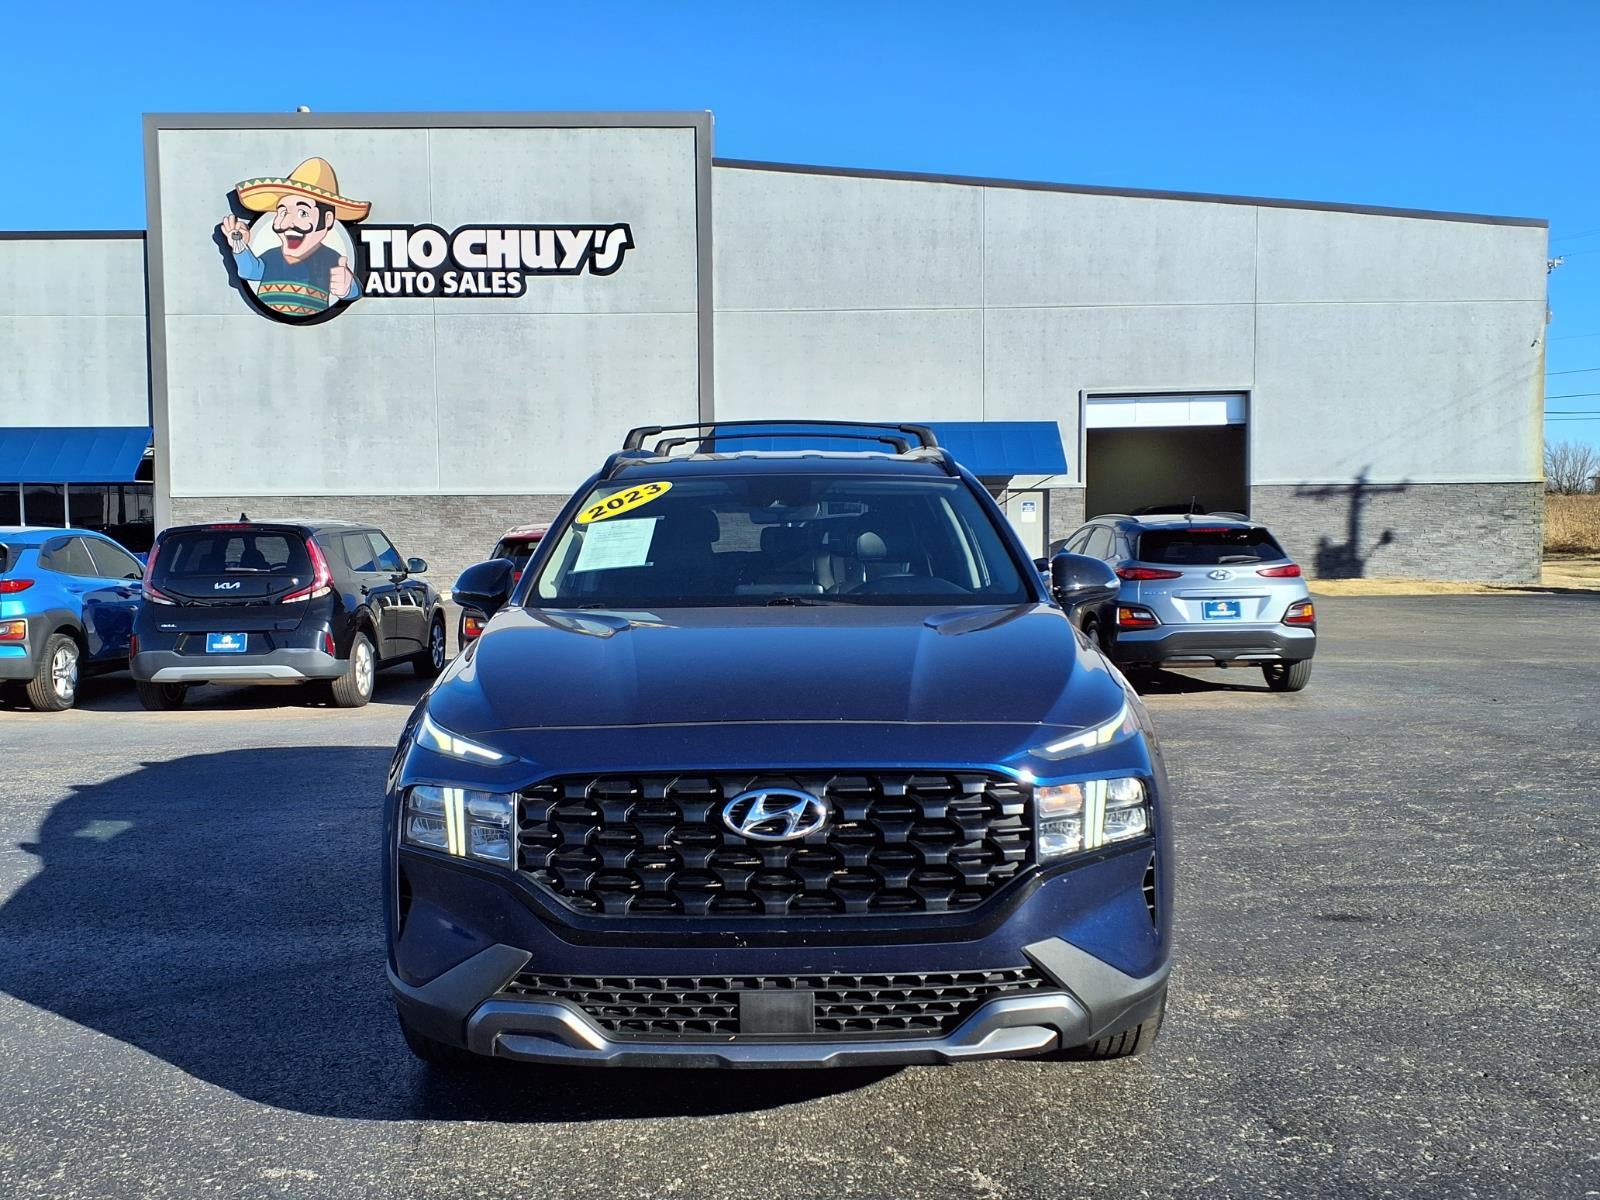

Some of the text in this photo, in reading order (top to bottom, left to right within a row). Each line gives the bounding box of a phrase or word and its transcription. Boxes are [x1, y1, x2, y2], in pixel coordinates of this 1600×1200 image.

[361, 228, 627, 269] TIO CHUY'S
[365, 271, 522, 294] AUTO SALES
[588, 484, 662, 519] 2023
